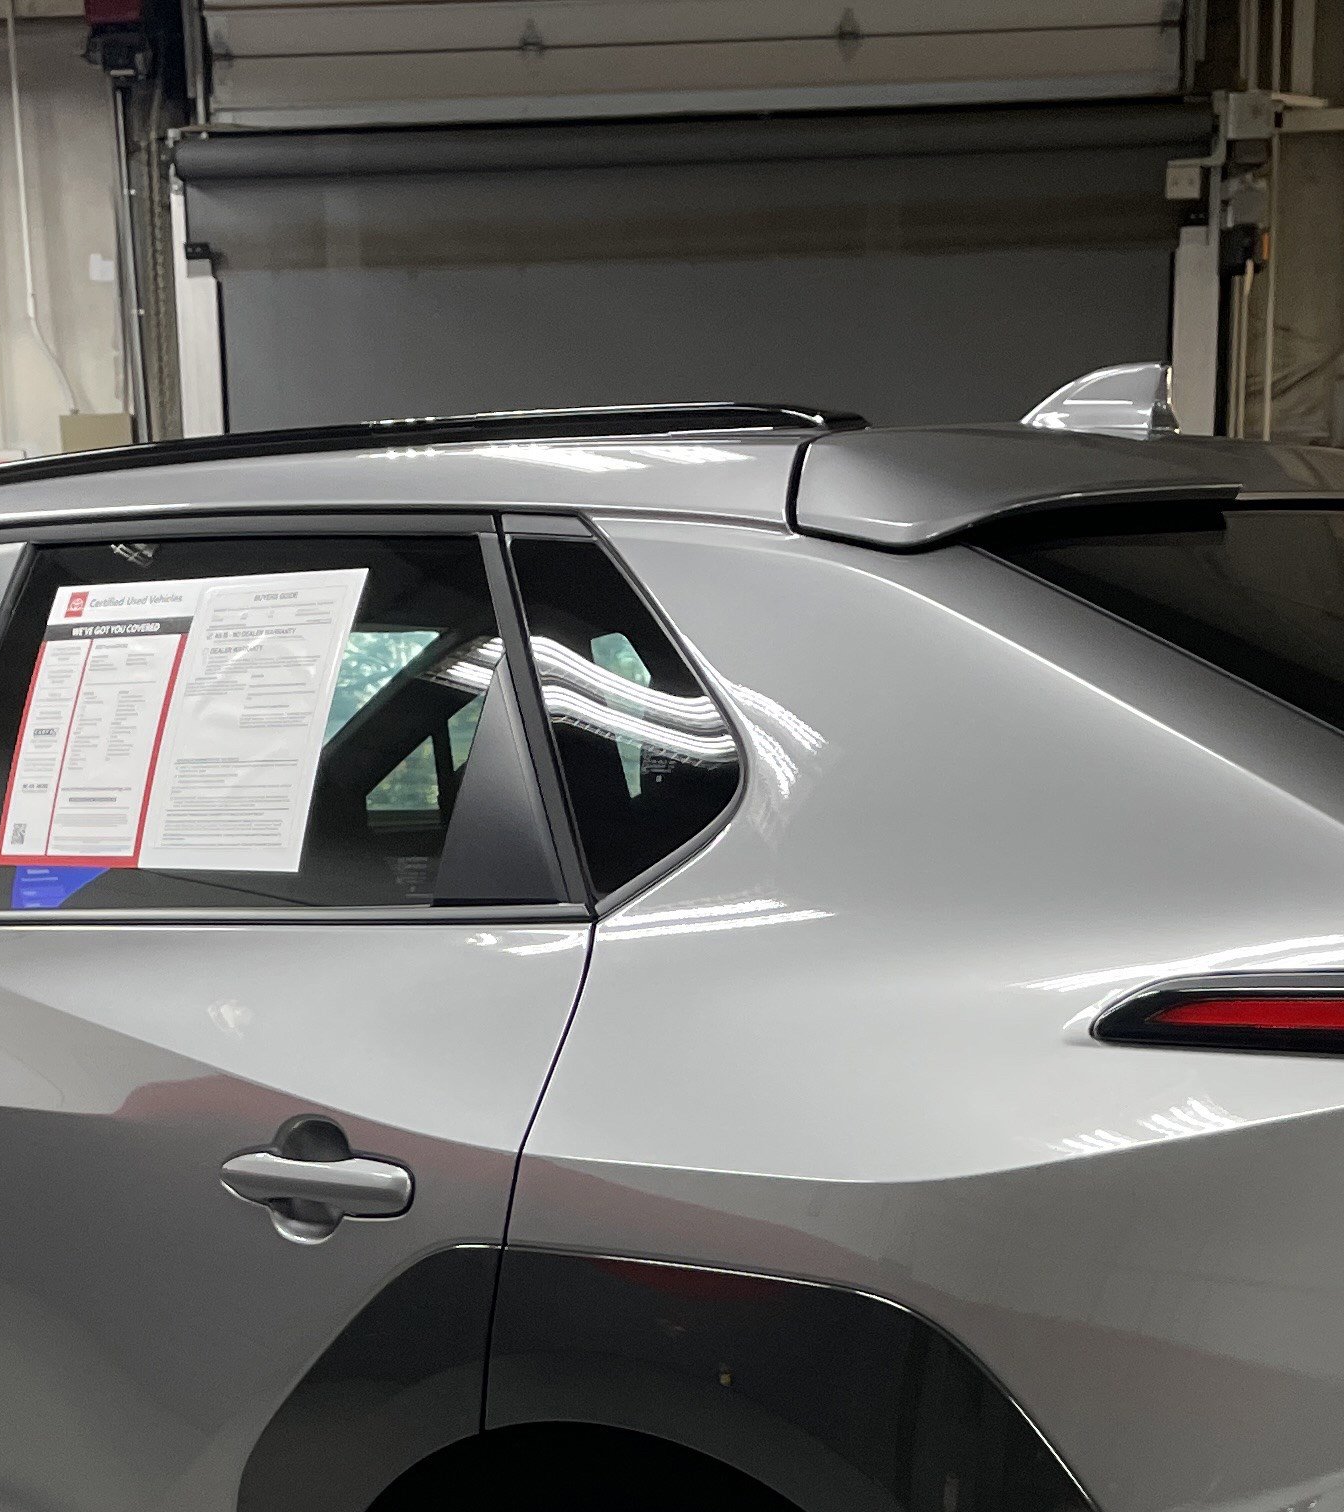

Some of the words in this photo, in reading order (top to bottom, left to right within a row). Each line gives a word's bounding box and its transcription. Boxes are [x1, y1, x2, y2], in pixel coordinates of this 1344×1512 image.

[89, 596, 125, 608] Certified
[127, 594, 147, 604] Used
[149, 592, 183, 603] Vehicles
[94, 625, 109, 635] GOT
[110, 624, 126, 634] YOU
[126, 622, 161, 633] COVERED
